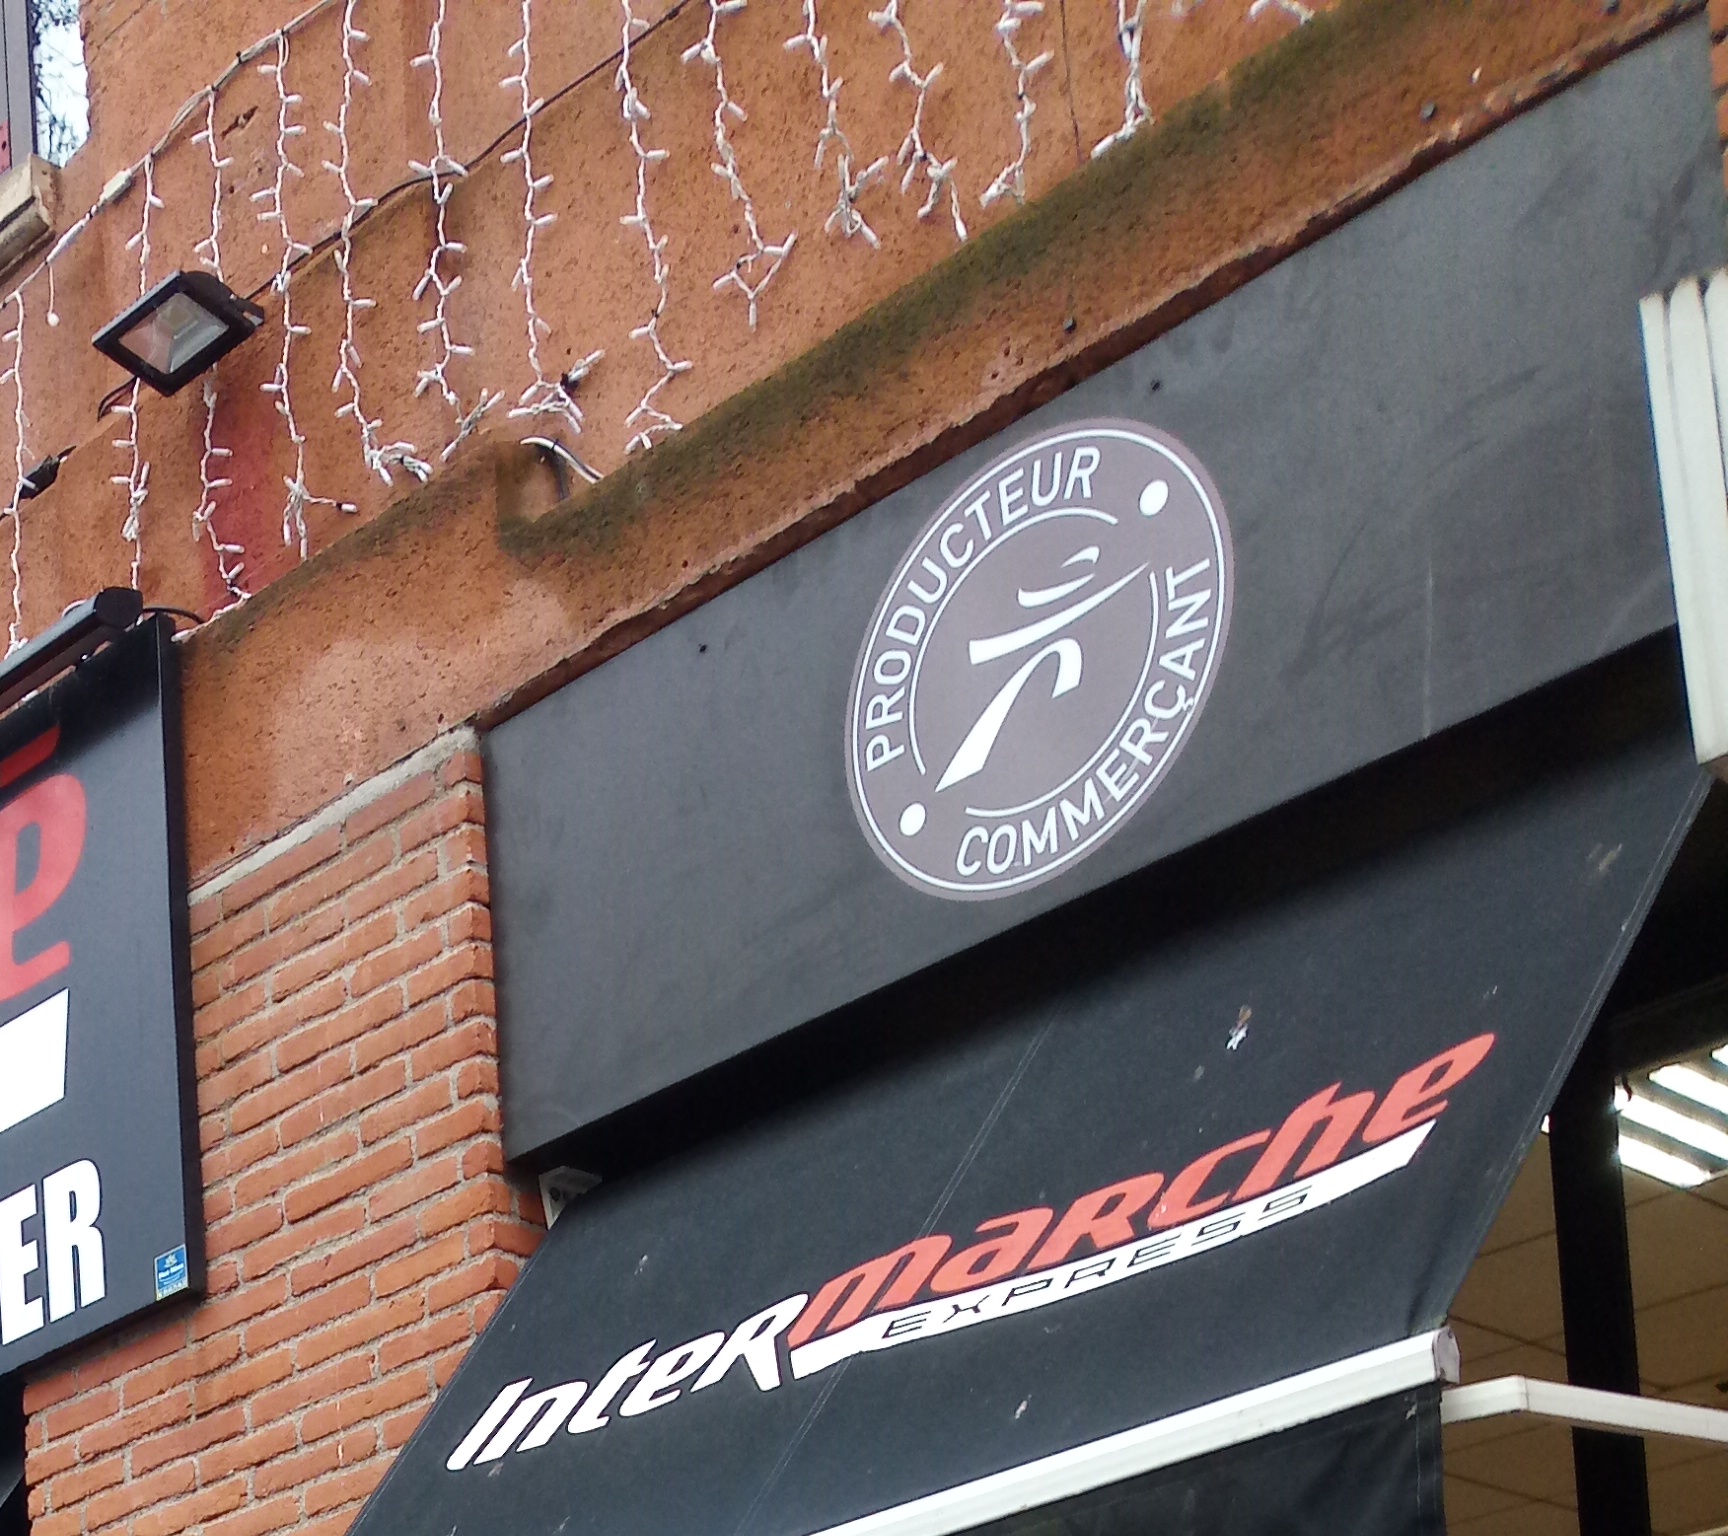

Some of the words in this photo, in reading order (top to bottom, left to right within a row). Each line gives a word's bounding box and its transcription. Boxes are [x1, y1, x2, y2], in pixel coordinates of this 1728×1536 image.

[865, 446, 1100, 772] PRODUCTEUR
[956, 559, 1212, 876] COMMERÇANT
[882, 1186, 1311, 1340] EXPRESS
